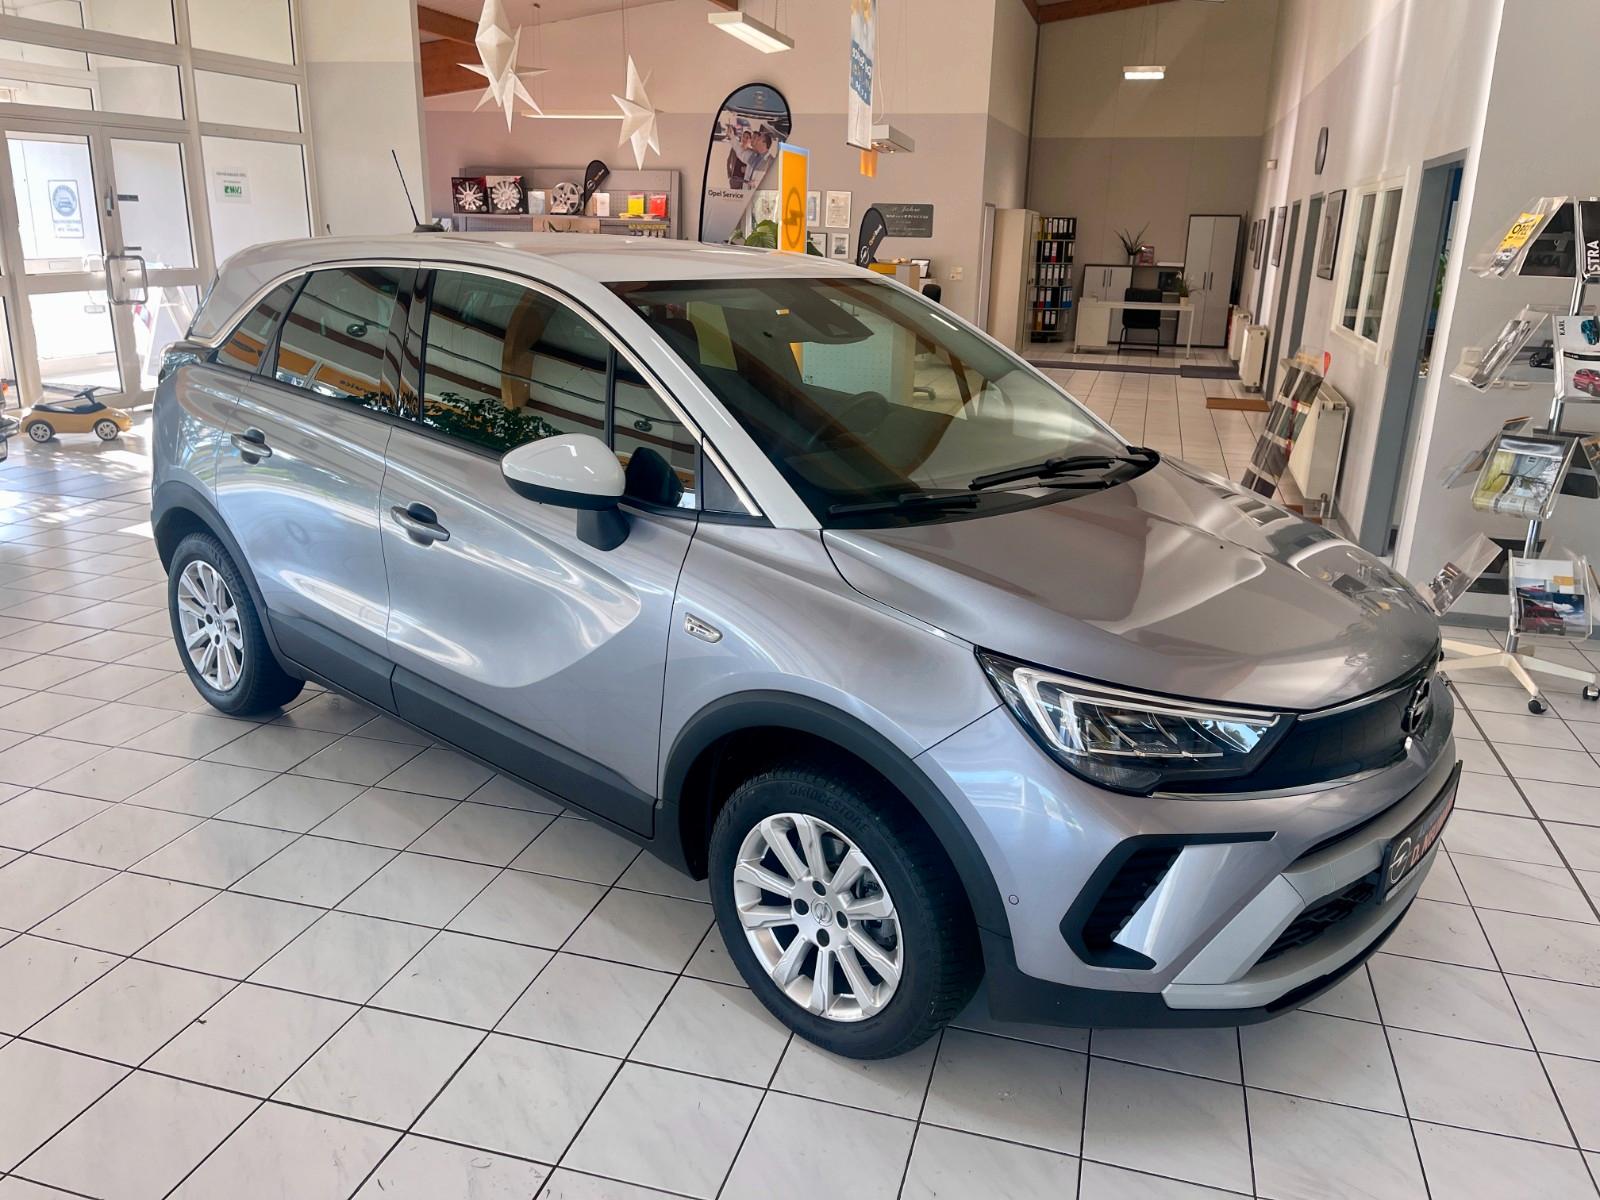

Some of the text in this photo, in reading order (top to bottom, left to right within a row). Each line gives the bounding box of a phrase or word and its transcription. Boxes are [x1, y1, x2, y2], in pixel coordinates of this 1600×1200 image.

[708, 190, 744, 199] Opel Service
[1587, 240, 1600, 271] STRA
